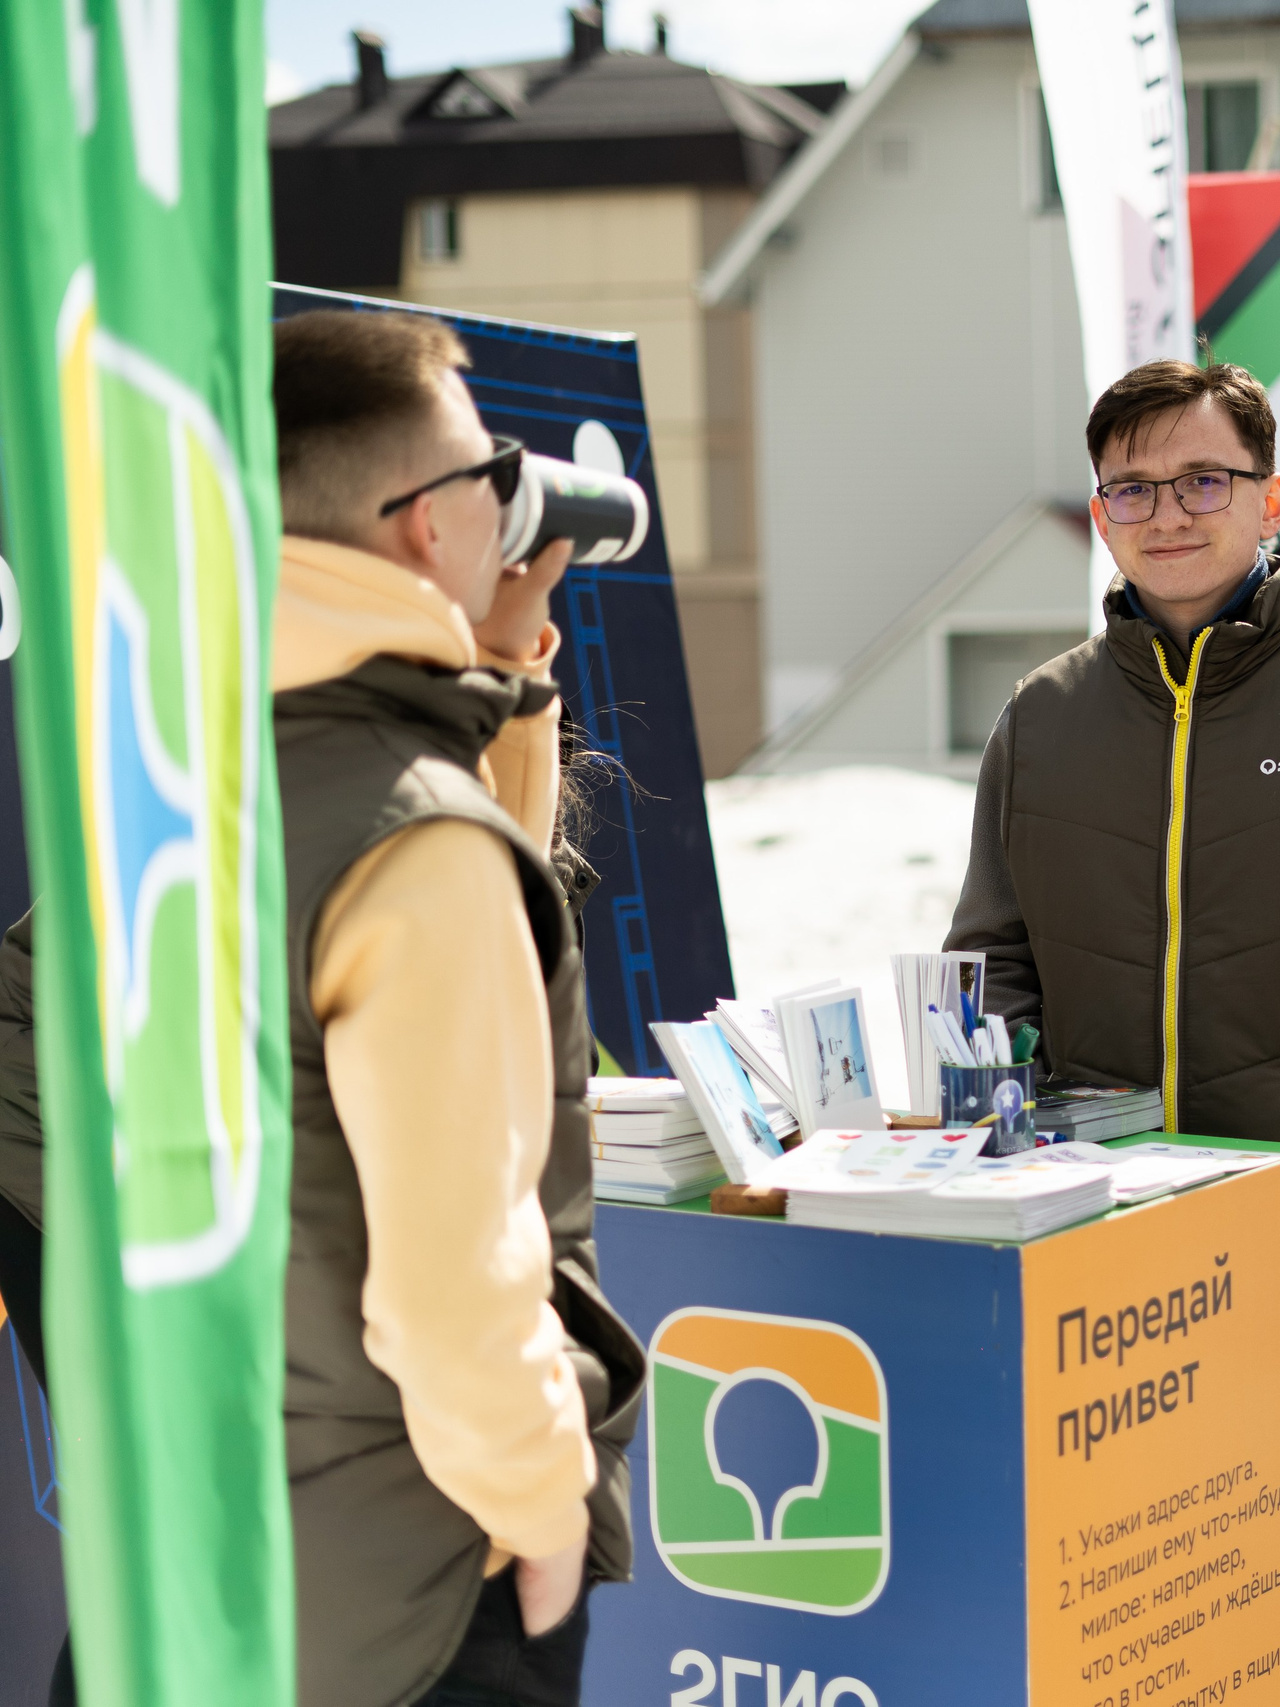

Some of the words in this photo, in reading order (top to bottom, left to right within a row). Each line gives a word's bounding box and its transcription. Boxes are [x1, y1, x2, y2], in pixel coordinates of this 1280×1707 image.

[1058, 1252, 1232, 1374] Передай
[1058, 1360, 1200, 1462] привет
[1058, 1536, 1072, 1565] 1.
[1079, 1511, 1141, 1556] Укажи
[1147, 1484, 1200, 1526] адрес
[1204, 1460, 1258, 1504] друга.
[1059, 1580, 1076, 1610] 2.
[1081, 1546, 1157, 1600] Напиши
[1163, 1527, 1197, 1560] ему
[1081, 1593, 1147, 1644] милое:
[1153, 1547, 1246, 1609] например,
[1082, 1654, 1114, 1684] что
[1119, 1608, 1206, 1667] скучаешь
[1211, 1598, 1221, 1621] и
[1136, 1658, 1191, 1702] гости.
[1232, 1669, 1243, 1691] в
